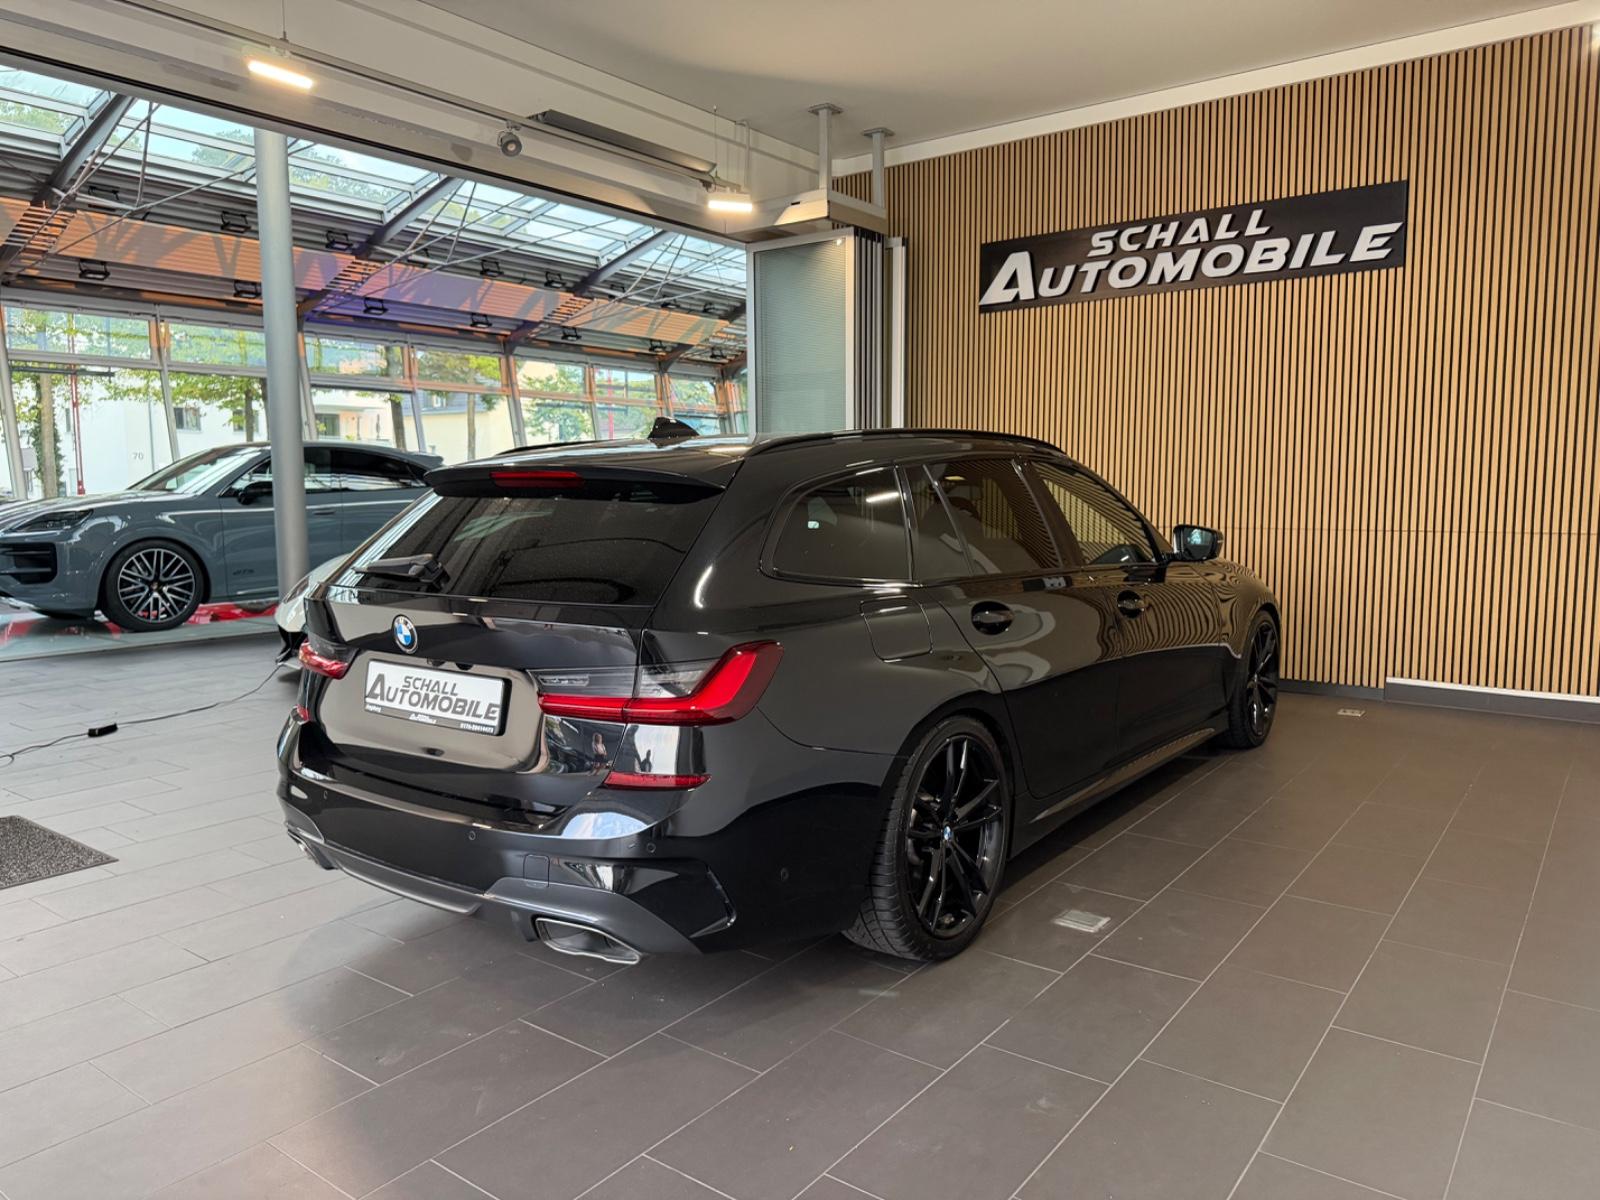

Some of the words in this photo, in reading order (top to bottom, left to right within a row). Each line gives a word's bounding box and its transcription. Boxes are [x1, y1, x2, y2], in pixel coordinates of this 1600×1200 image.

[1088, 209, 1271, 257] SCHALL
[979, 222, 1403, 306] AUTOMOBILE
[131, 451, 144, 460] 70
[366, 673, 501, 721] AUTOMOBILE
[402, 675, 459, 697] SCHALL
